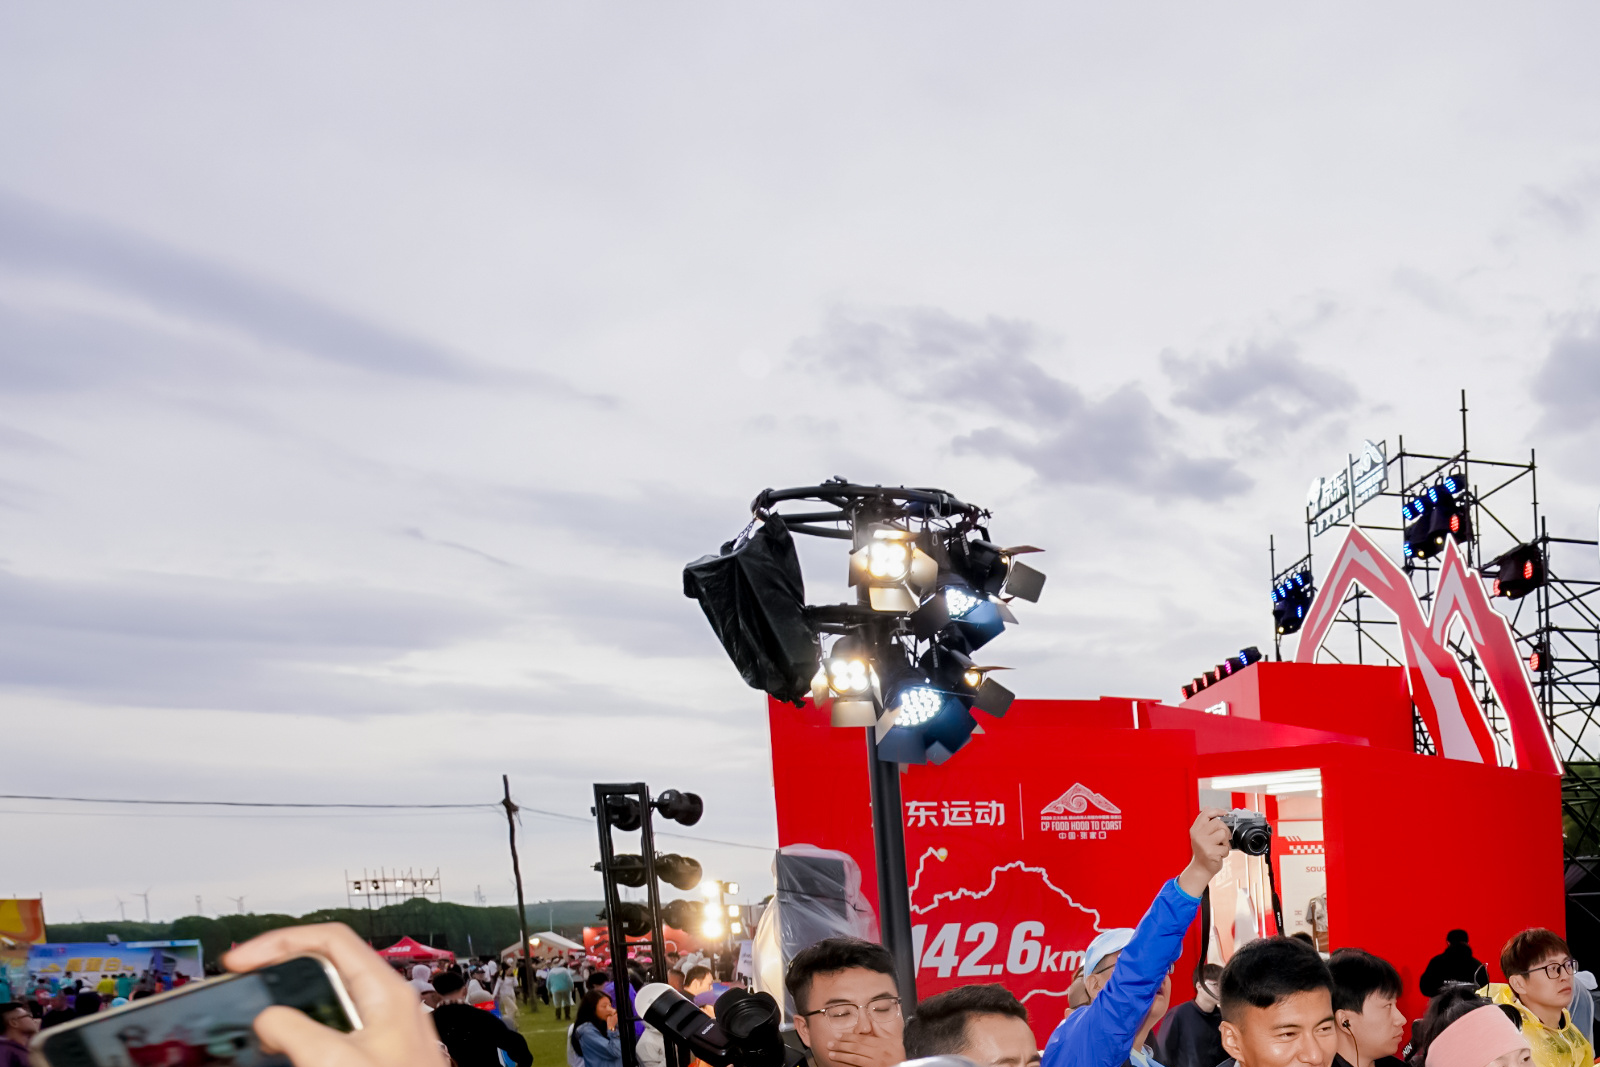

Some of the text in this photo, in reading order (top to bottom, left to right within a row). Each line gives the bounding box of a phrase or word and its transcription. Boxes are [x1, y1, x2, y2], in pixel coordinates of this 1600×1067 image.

[1041, 820, 1122, 831] CP FOOD HOOD TO COAST
